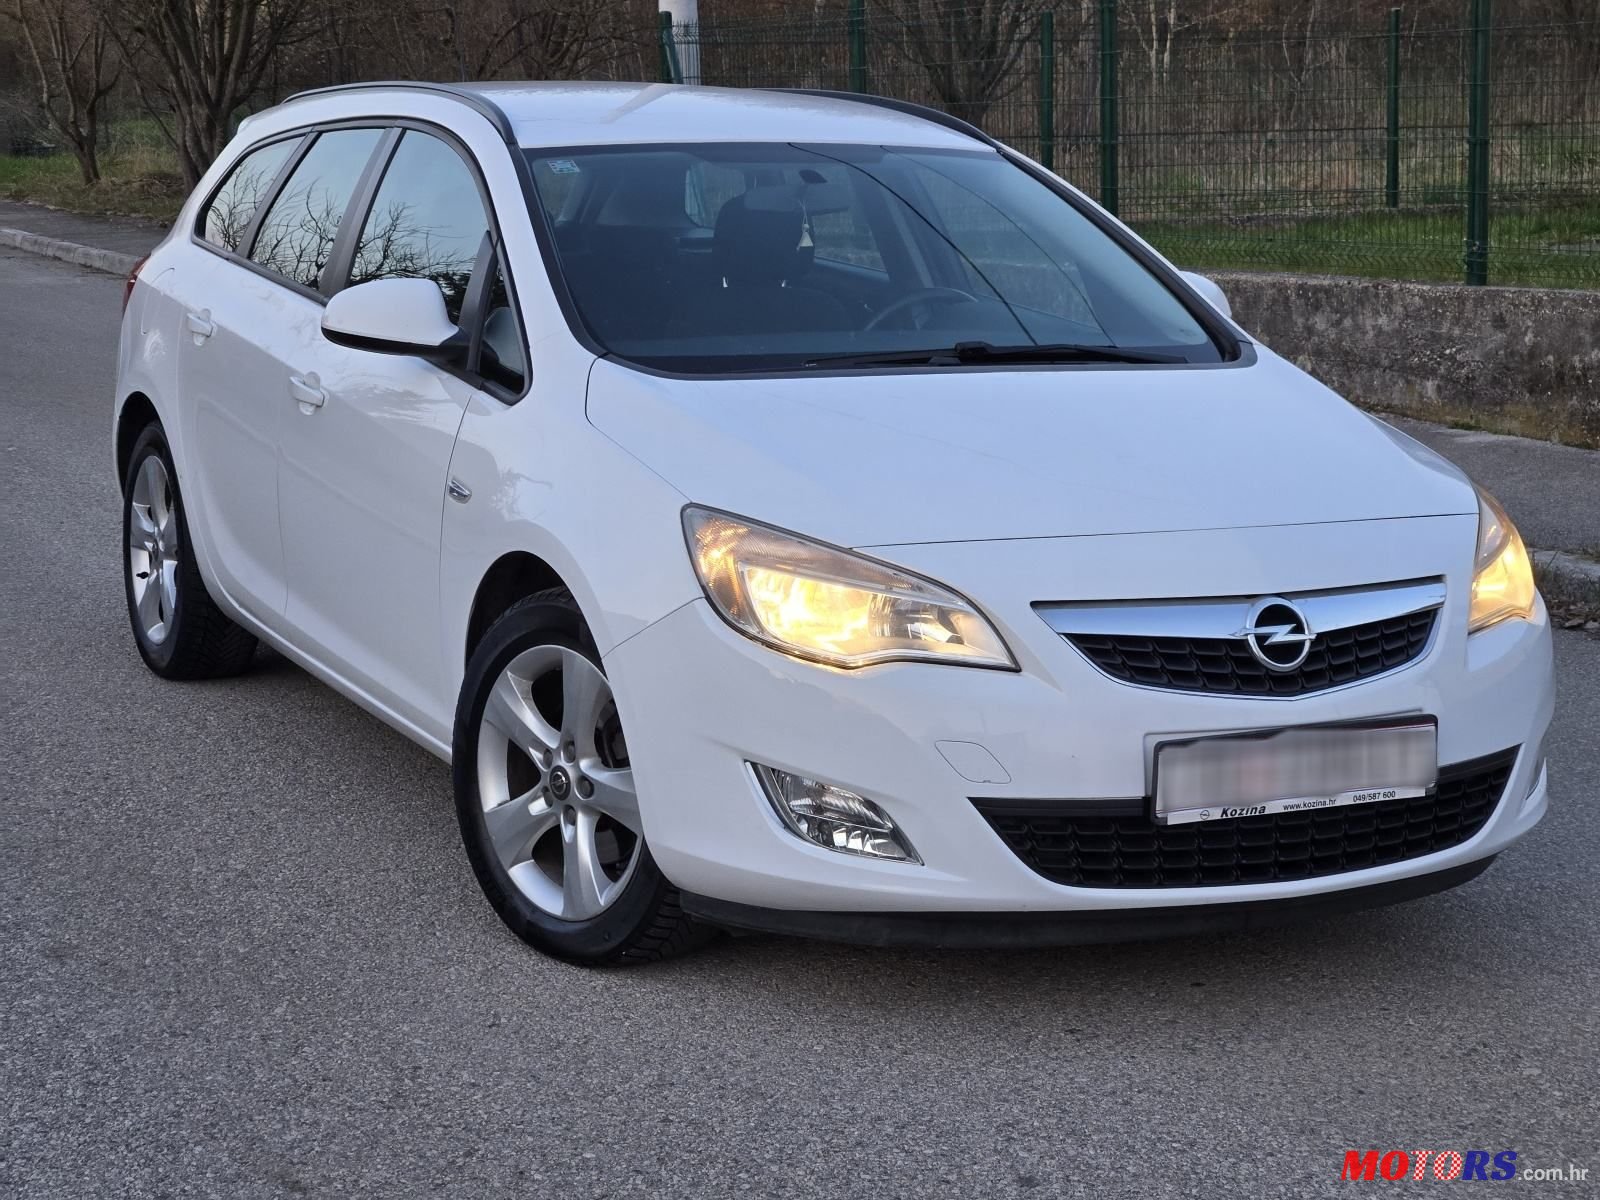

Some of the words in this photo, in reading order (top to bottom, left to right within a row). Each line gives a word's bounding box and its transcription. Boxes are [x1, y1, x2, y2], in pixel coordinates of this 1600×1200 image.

[1220, 805, 1267, 818] Kozina
[1282, 798, 1337, 811] www.kozina.hr
[1353, 792, 1381, 803] 049/587
[1382, 790, 1396, 799] 600
